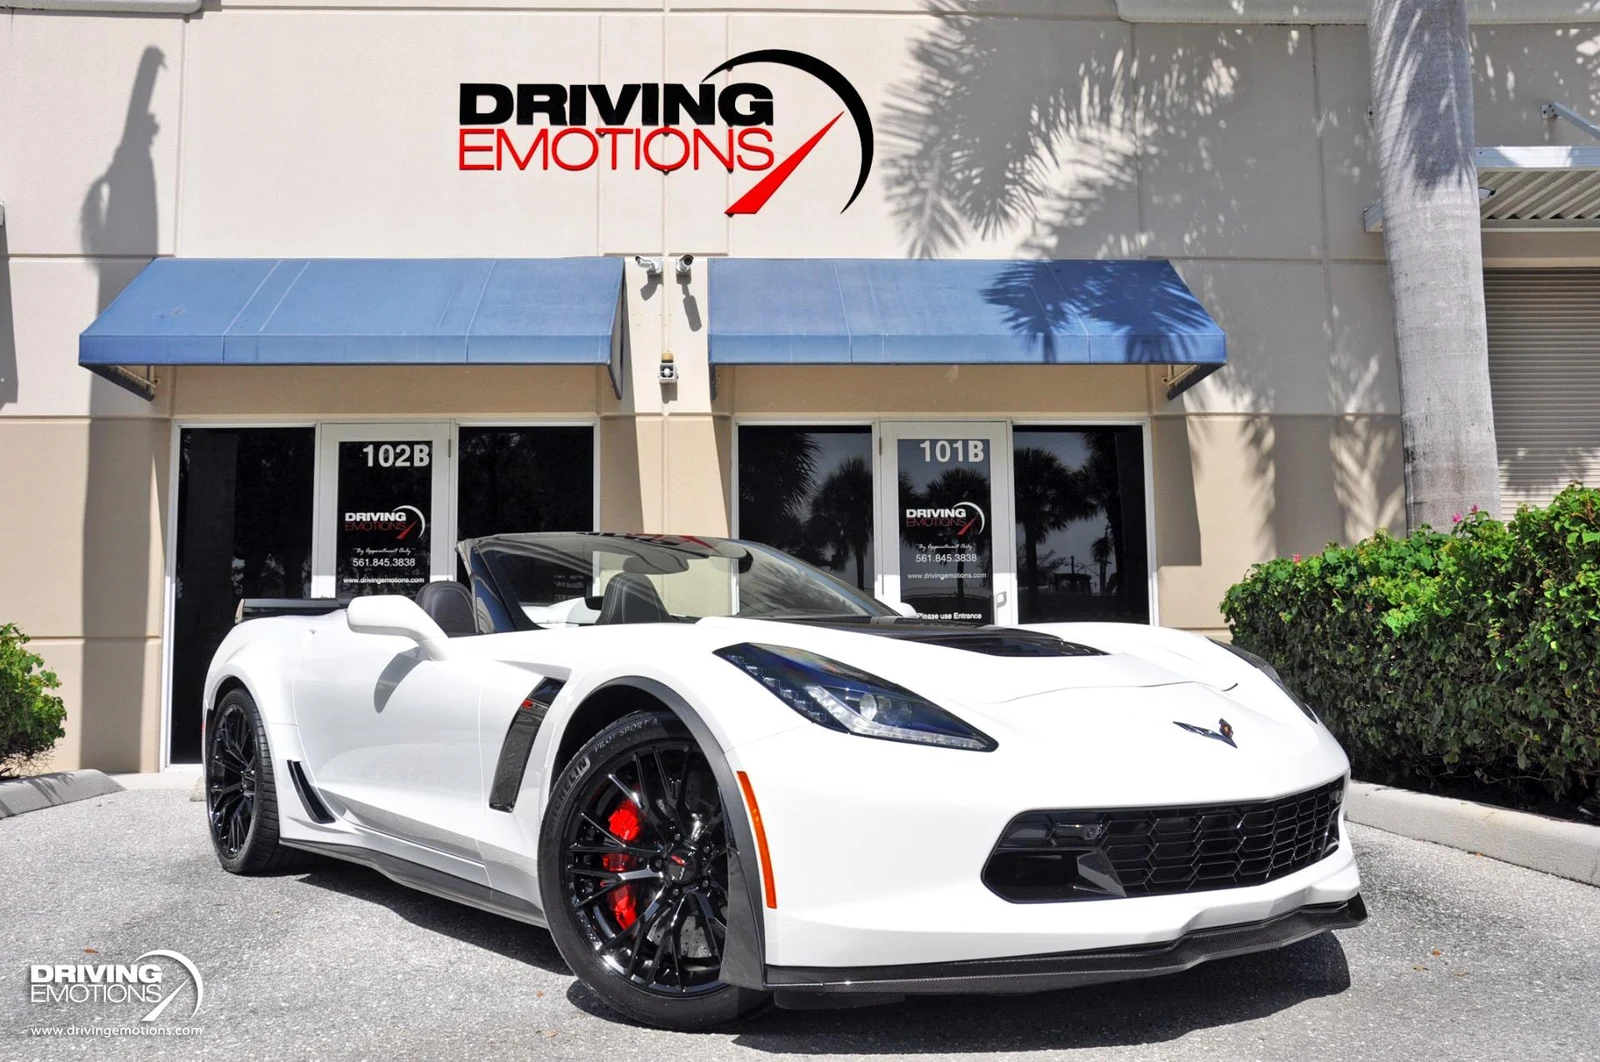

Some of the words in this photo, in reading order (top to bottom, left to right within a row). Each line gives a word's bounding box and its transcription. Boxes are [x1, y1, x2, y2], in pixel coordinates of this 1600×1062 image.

[459, 82, 774, 127] DRIVING
[458, 127, 775, 172] EMOTIONS
[363, 444, 430, 467] 102B
[920, 440, 984, 463] 101B
[345, 512, 406, 522] DRIVING
[906, 508, 966, 518] DRIVING
[344, 522, 407, 531] EMOTIONS
[906, 518, 967, 527] EMOTIONS
[352, 558, 416, 567] 561.845.3838
[915, 553, 977, 563] 561.845.3838
[343, 576, 425, 585] www.drivingemotions.com
[907, 572, 987, 581] www.drivingemotions.com
[916, 612, 940, 620] Please
[953, 612, 983, 620] Entrance
[619, 719, 649, 737] SPORT
